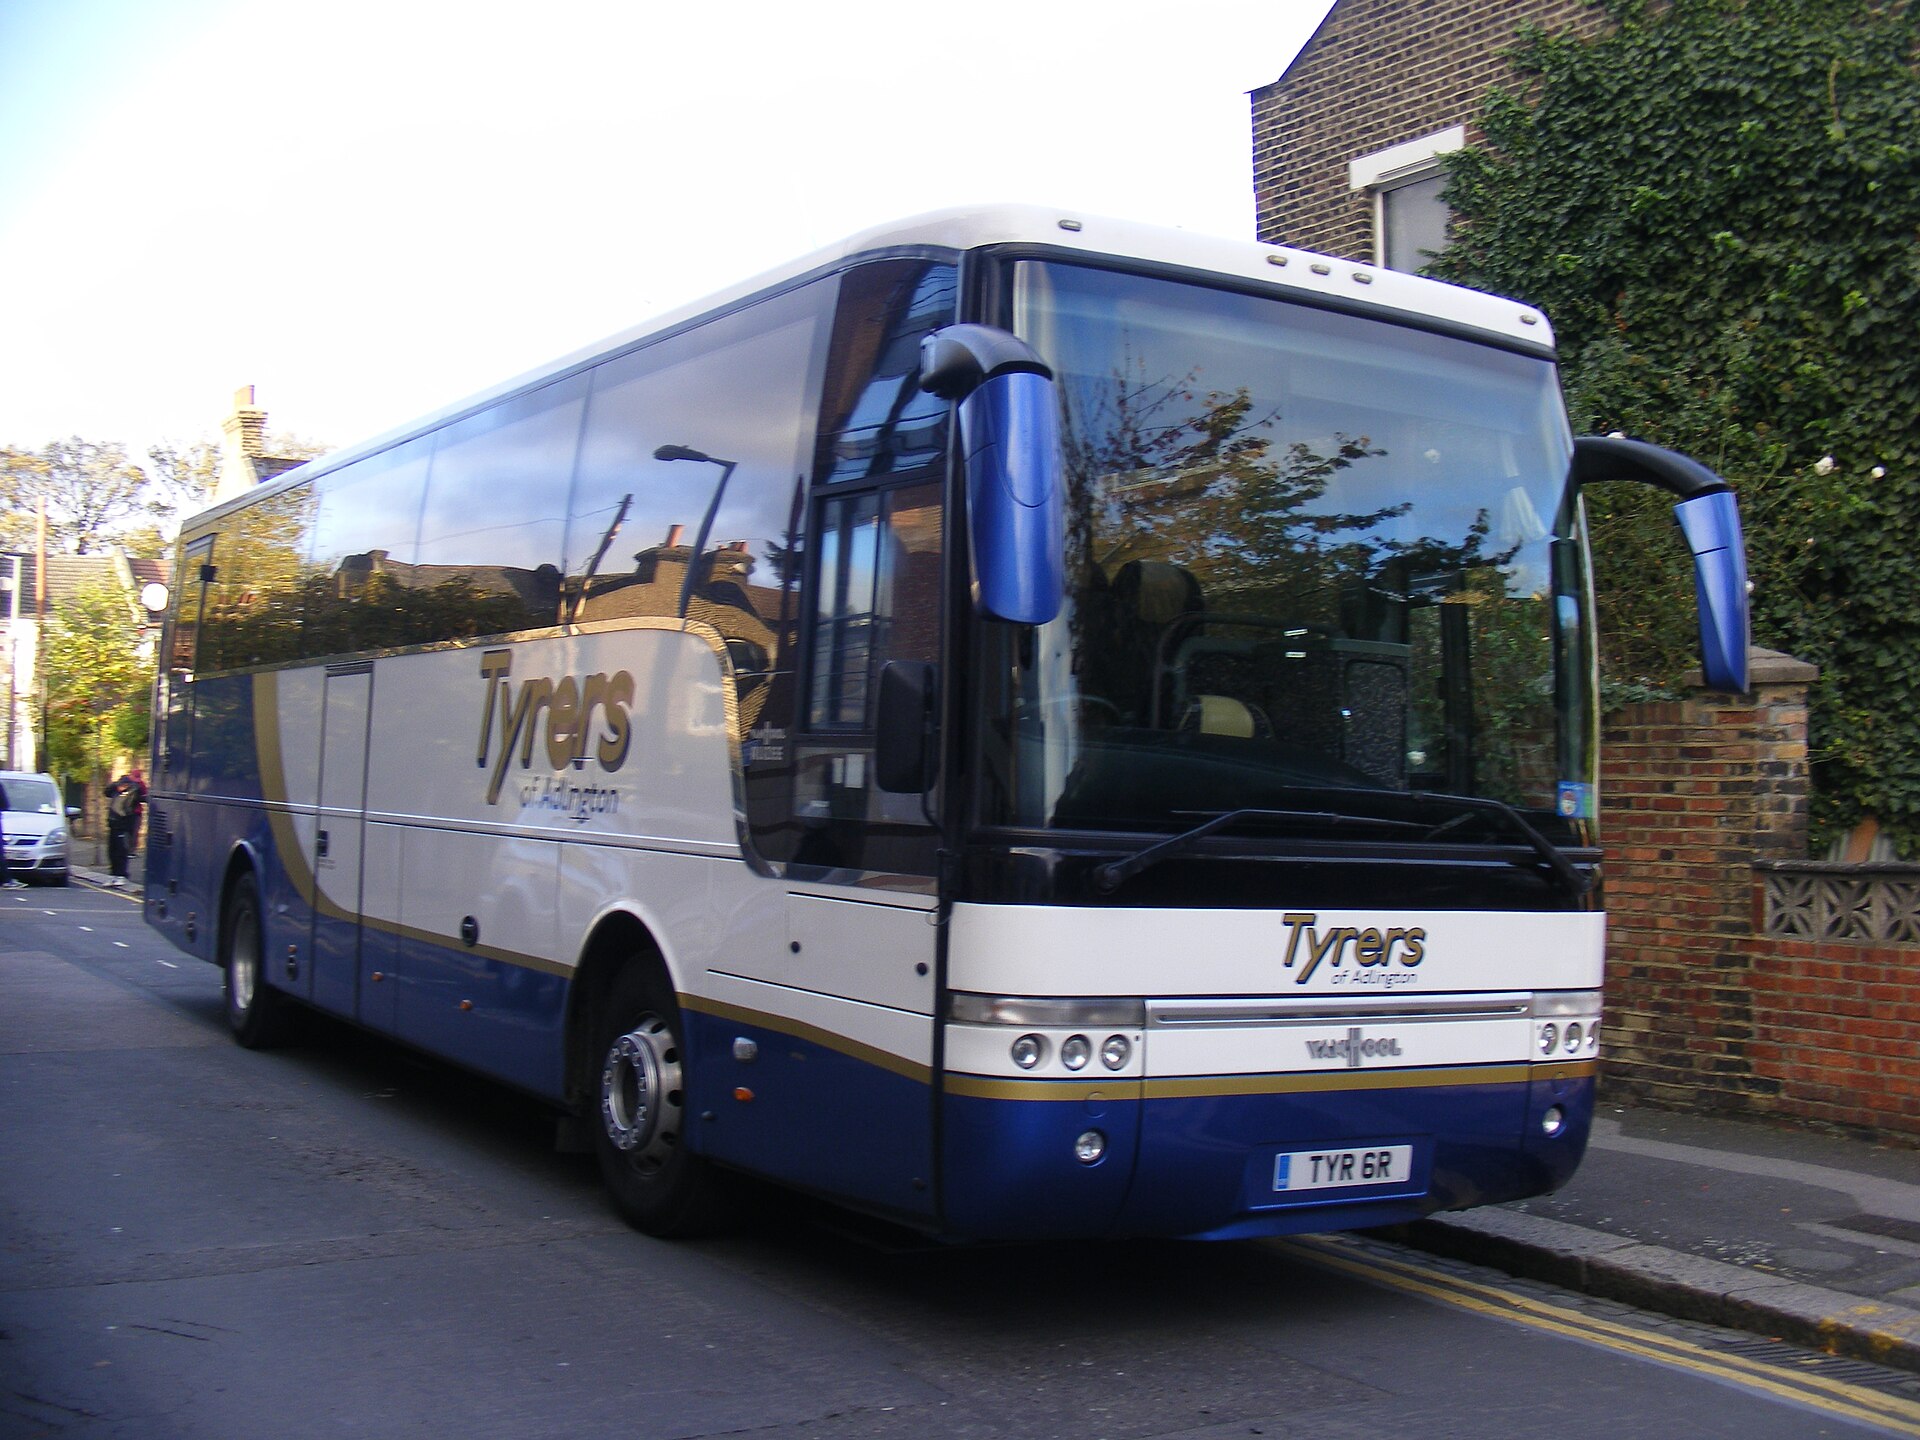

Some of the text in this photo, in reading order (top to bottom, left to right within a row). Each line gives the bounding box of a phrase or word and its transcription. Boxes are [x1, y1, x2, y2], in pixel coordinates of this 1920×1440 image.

[476, 648, 637, 806] Tyrers
[1282, 912, 1427, 985] Tyrers
[1331, 969, 1419, 989] of Adlington
[1309, 1151, 1391, 1183] TYR 6R
